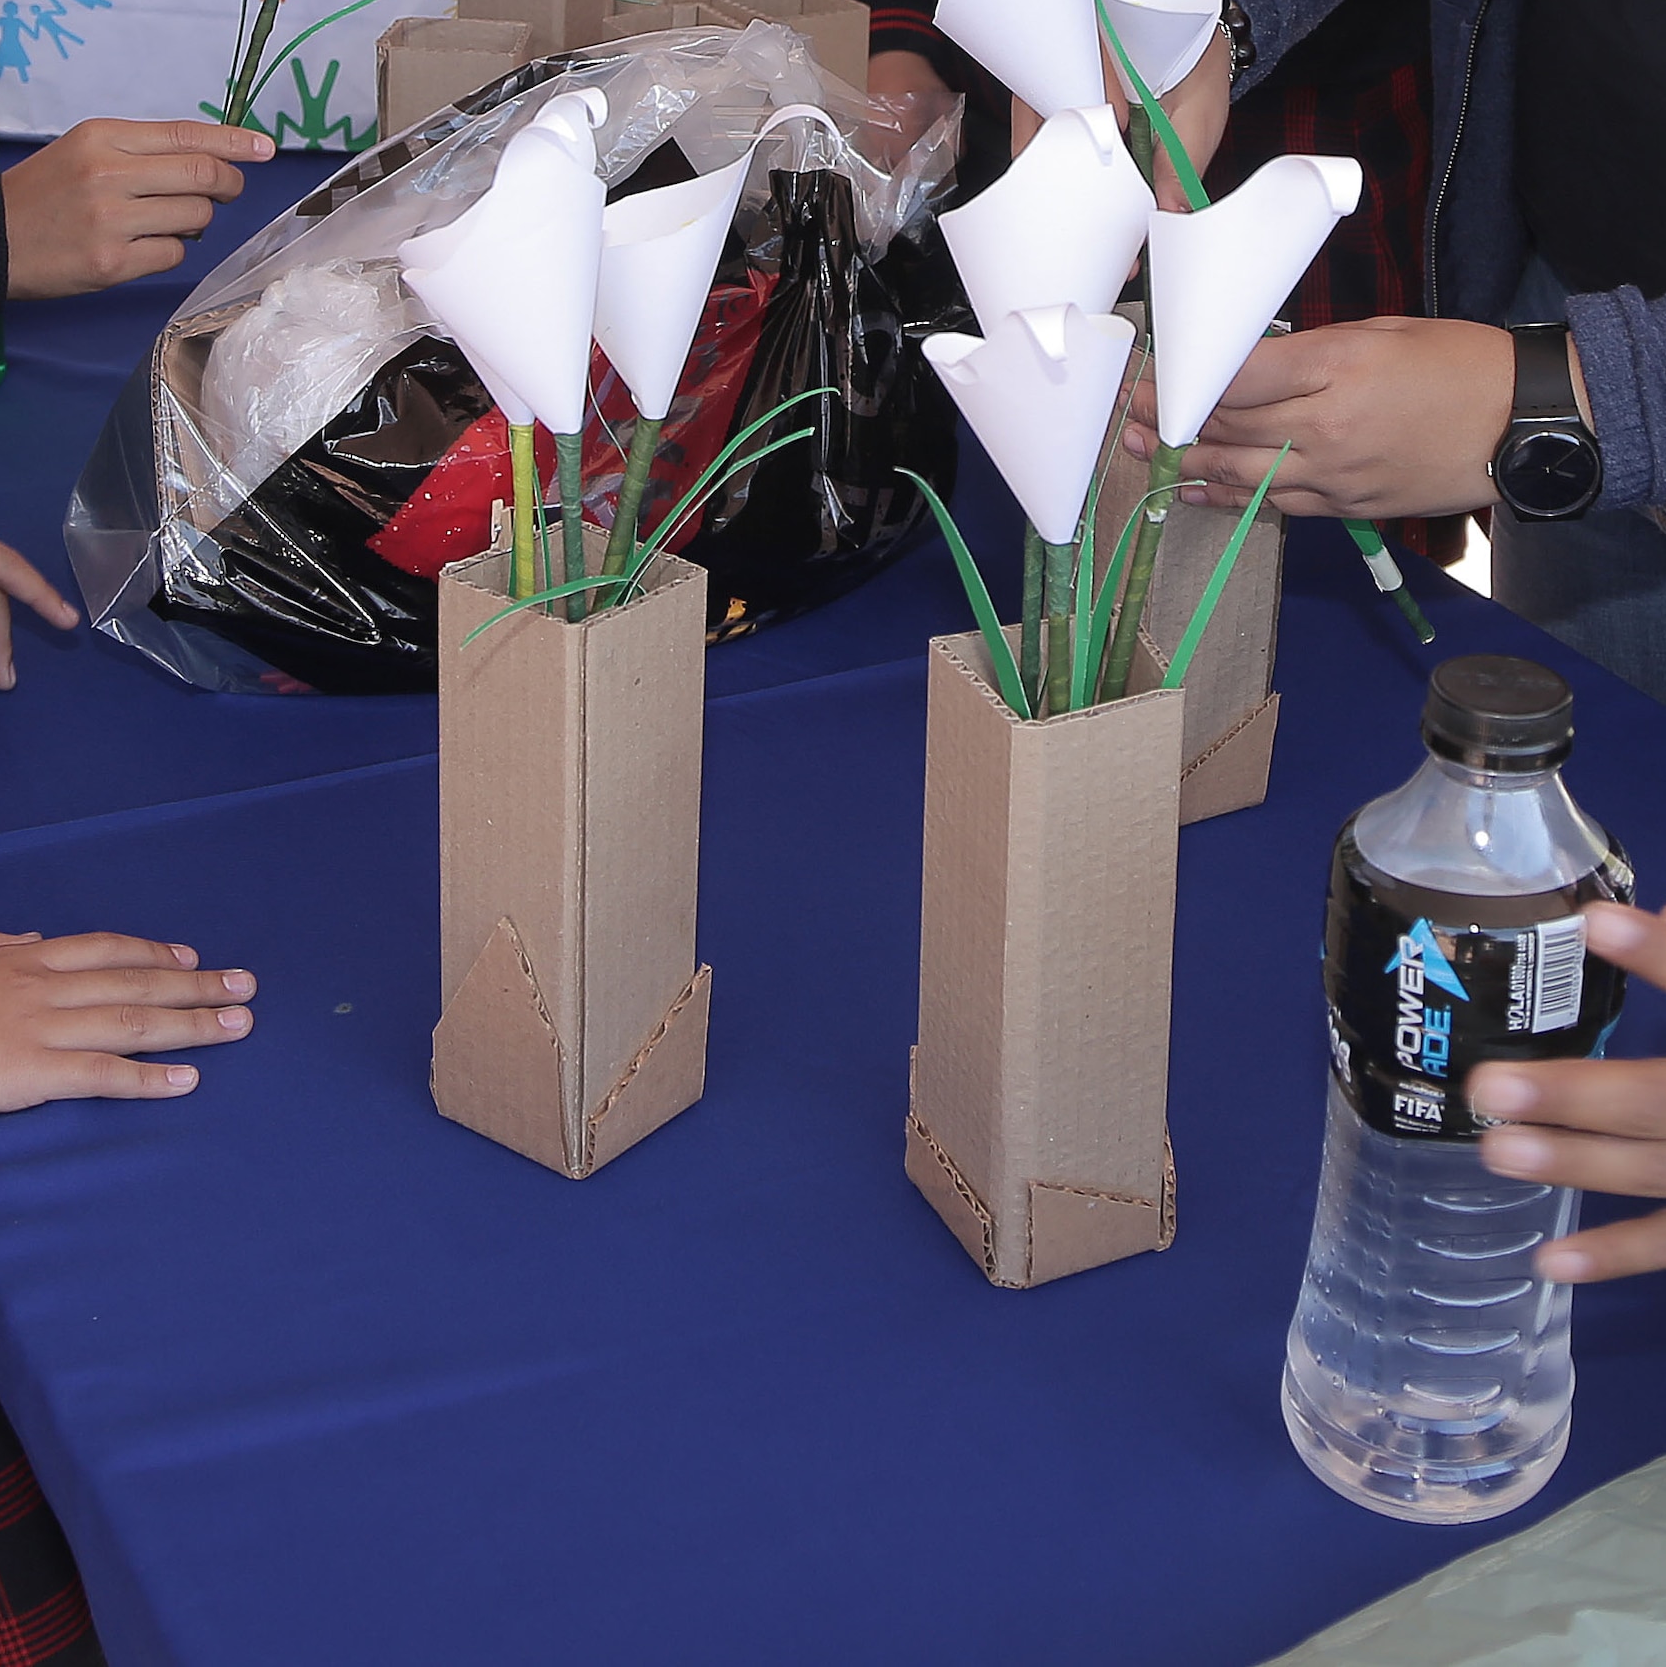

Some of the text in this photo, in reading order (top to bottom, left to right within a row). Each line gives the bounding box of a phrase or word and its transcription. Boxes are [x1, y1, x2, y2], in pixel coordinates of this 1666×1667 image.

[1395, 934, 1426, 1072] POWER
[1507, 990, 1526, 1031] HOLA
[1420, 1005, 1452, 1078] ADE
[1393, 1092, 1445, 1123] FIFA
